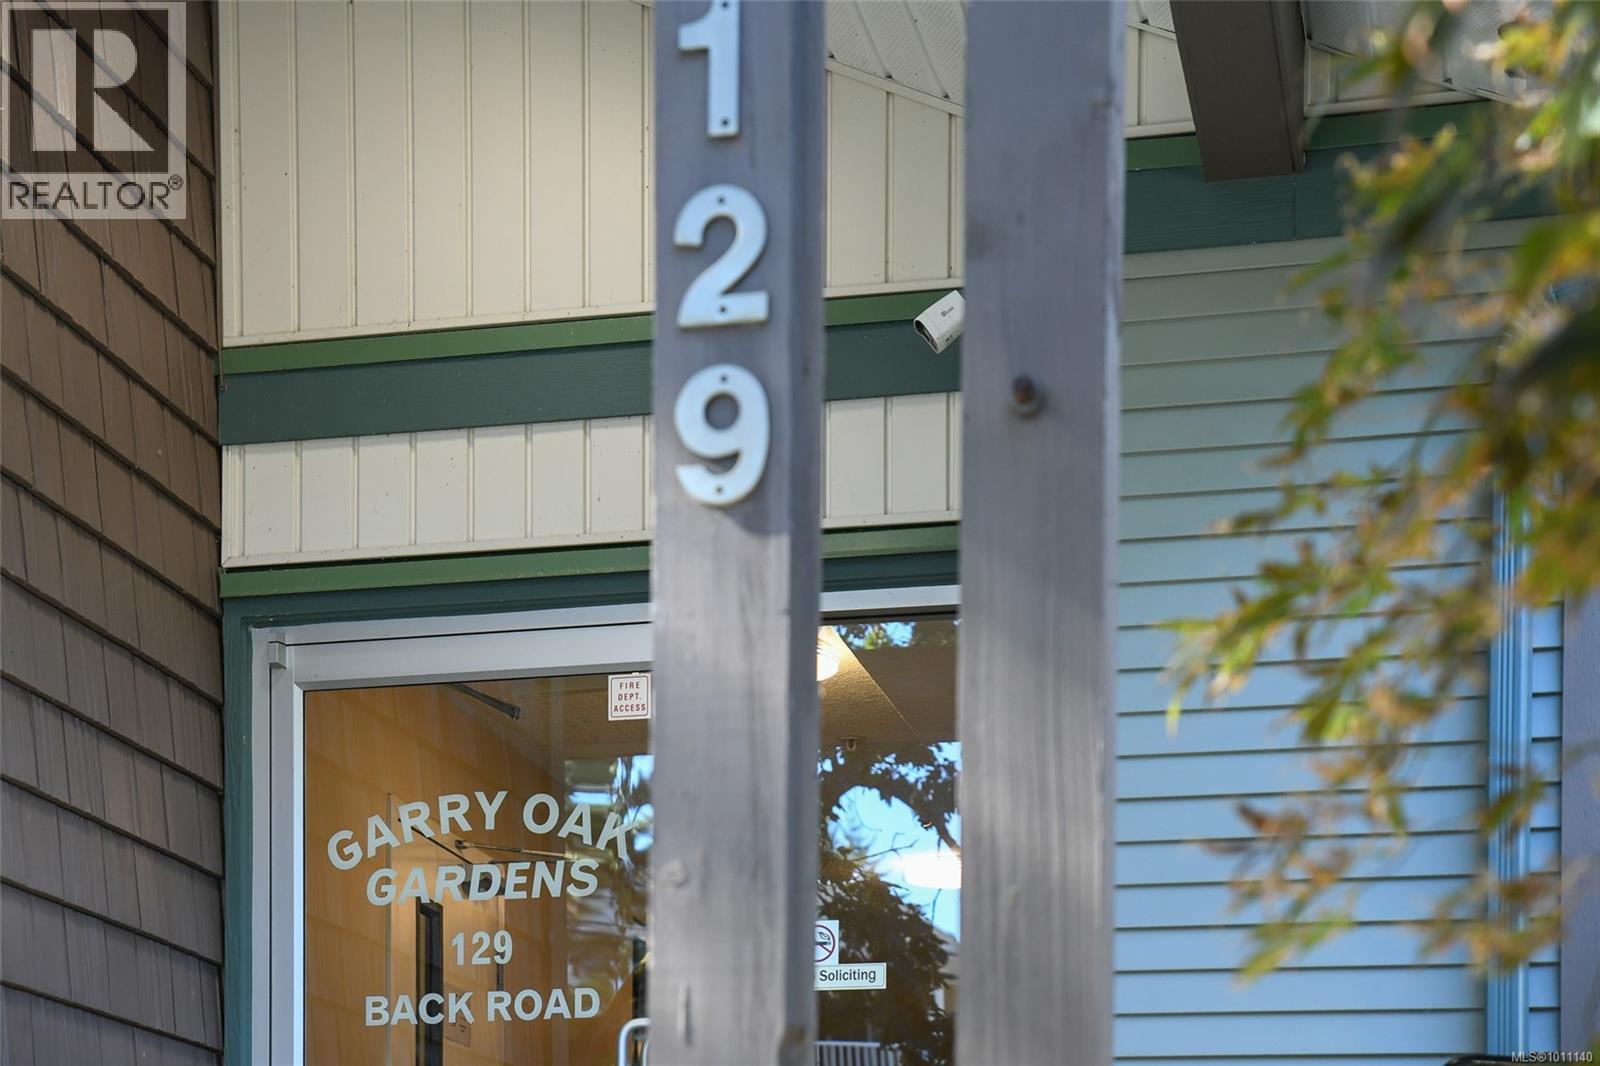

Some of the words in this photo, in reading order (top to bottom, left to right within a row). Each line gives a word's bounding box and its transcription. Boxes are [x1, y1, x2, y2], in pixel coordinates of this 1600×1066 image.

[673, 0, 771, 507] 129
[617, 693, 642, 702] DEPT.
[619, 681, 640, 690] FIRE
[613, 703, 646, 713] ACCESS
[327, 791, 508, 870] GARRY
[522, 793, 633, 859] OAK
[366, 859, 599, 906] GARDENS
[450, 930, 514, 966] 129
[819, 969, 876, 983] Soliciting
[364, 991, 475, 1027] BACK
[487, 987, 601, 1023] ROAD
